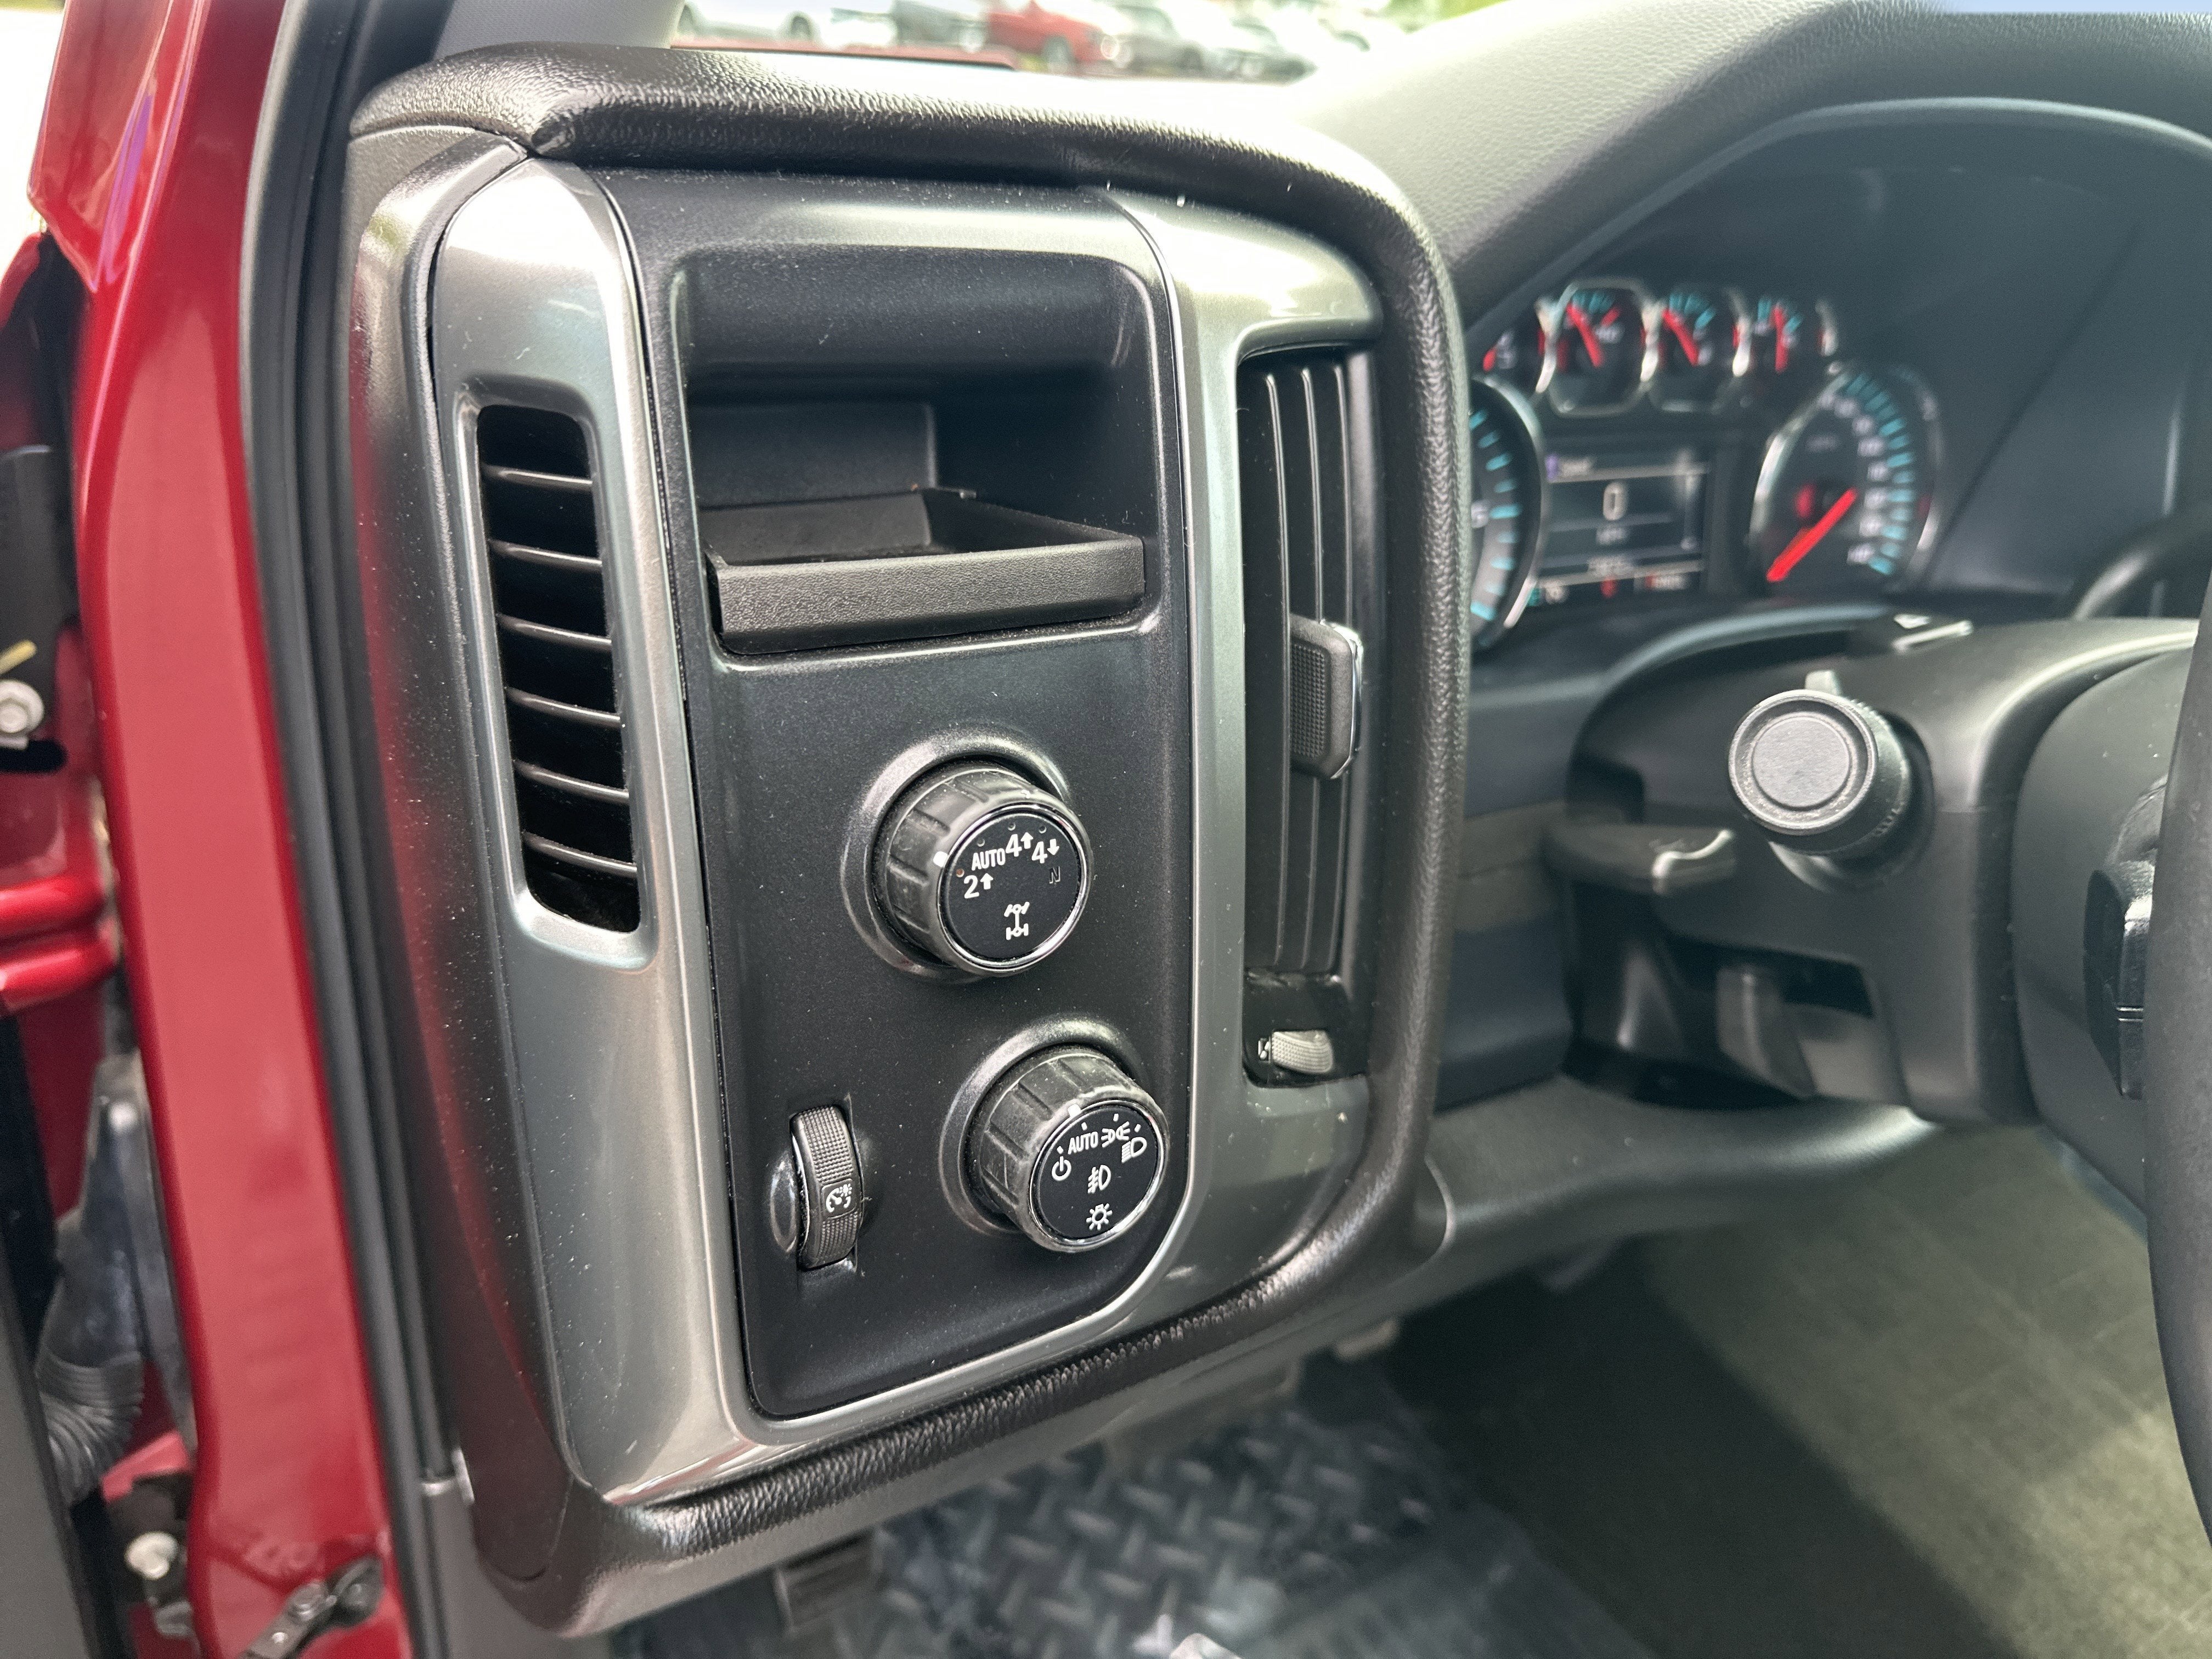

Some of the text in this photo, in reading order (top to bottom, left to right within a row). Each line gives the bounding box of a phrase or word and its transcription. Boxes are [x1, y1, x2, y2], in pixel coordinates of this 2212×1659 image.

[1602, 482, 1626, 521] 0
[1006, 834, 1022, 856] 4
[1031, 842, 1047, 864] 4
[972, 848, 1006, 871] AUTO
[1049, 866, 1061, 884] N
[964, 875, 979, 899] 2
[1068, 1132, 1098, 1154] AUTO
